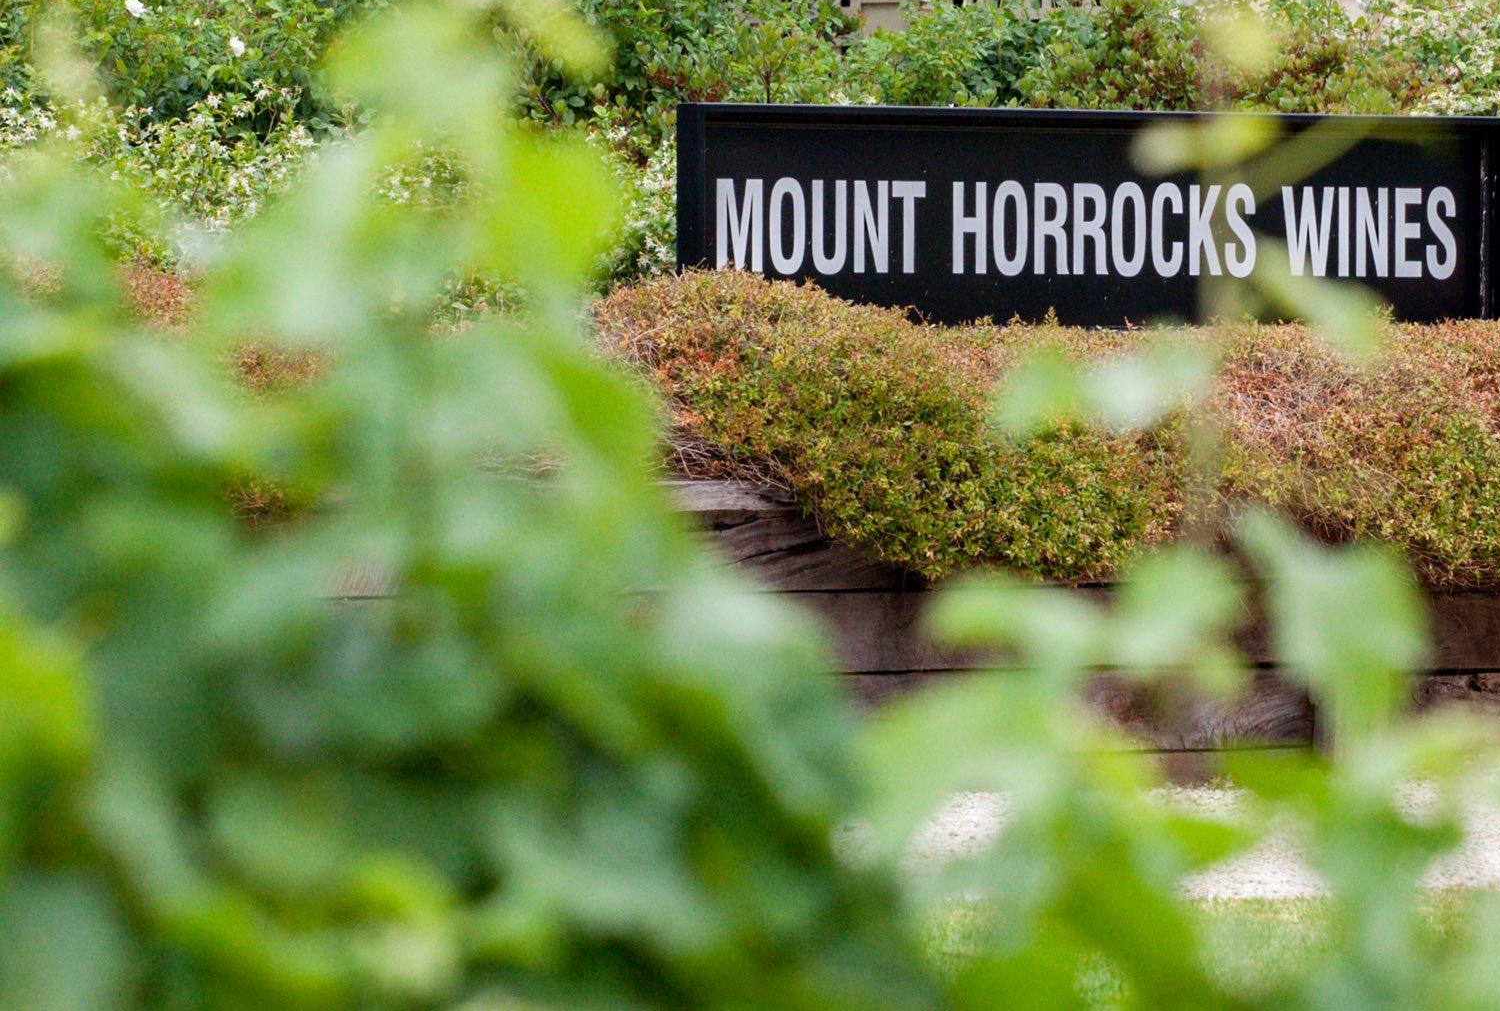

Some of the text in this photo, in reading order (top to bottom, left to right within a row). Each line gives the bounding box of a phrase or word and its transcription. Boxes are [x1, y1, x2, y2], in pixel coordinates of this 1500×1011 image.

[715, 177, 1457, 280] MOUNT HORROCKS WINES
